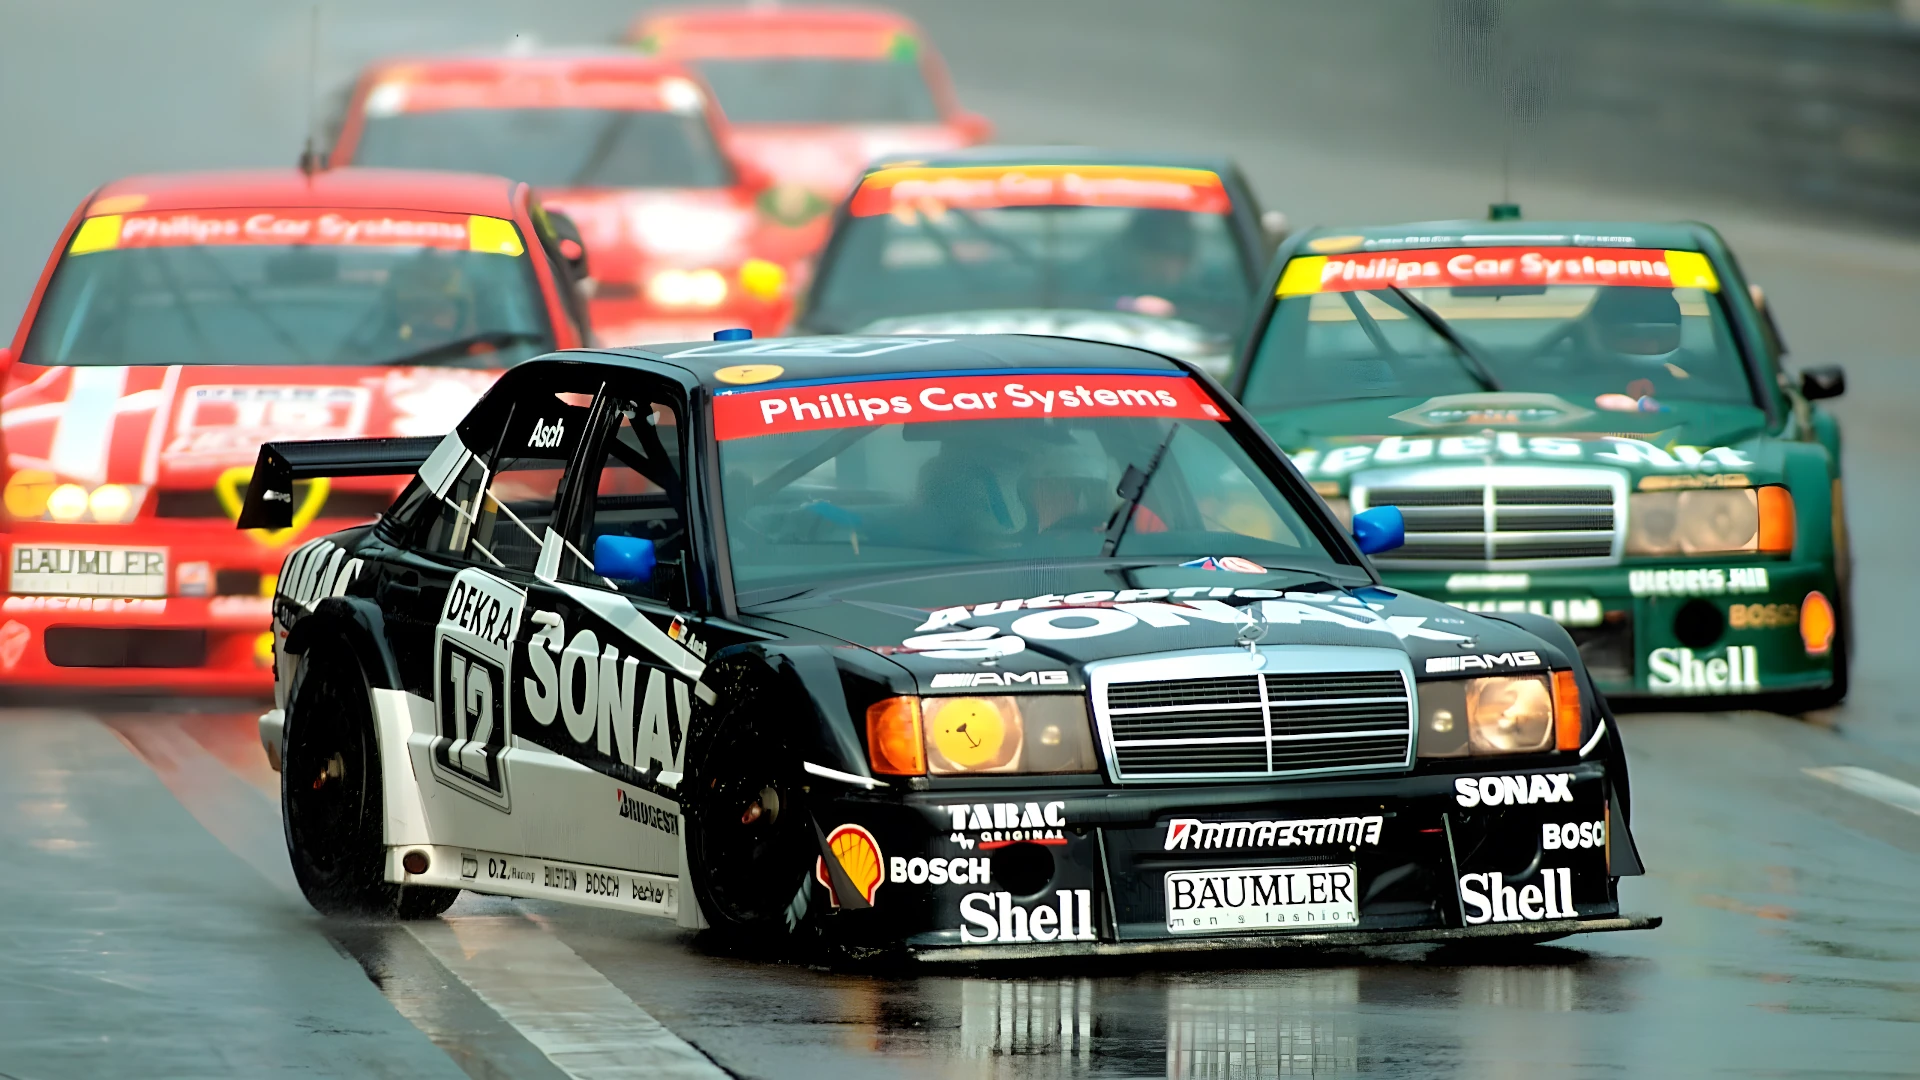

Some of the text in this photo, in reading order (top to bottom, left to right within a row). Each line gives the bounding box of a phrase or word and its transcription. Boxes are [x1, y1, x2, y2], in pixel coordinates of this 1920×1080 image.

[245, 213, 312, 236] Car
[1321, 251, 1671, 283] Philips Car Systems
[759, 382, 1178, 425] Philips Car Systems
[527, 417, 564, 448] Asch
[446, 579, 515, 650] DEKRA
[902, 599, 1475, 659] SONAX
[1458, 651, 1541, 669] AMG
[1648, 645, 1761, 694] Shell
[972, 670, 1069, 687] AMG
[449, 651, 494, 783] 12
[1455, 773, 1574, 808] SONAX
[947, 801, 1066, 831] TABAC
[980, 829, 1064, 842] ORIGINAL
[1163, 816, 1384, 851] BRIDGESTONE
[585, 872, 620, 898] BOSCH
[889, 857, 991, 885] BOSCH
[632, 878, 665, 903] becker
[1171, 871, 1353, 911] BÄUMLER
[1459, 867, 1579, 924] Shell
[959, 889, 1096, 944] Shell
[1264, 909, 1357, 924] fashion
